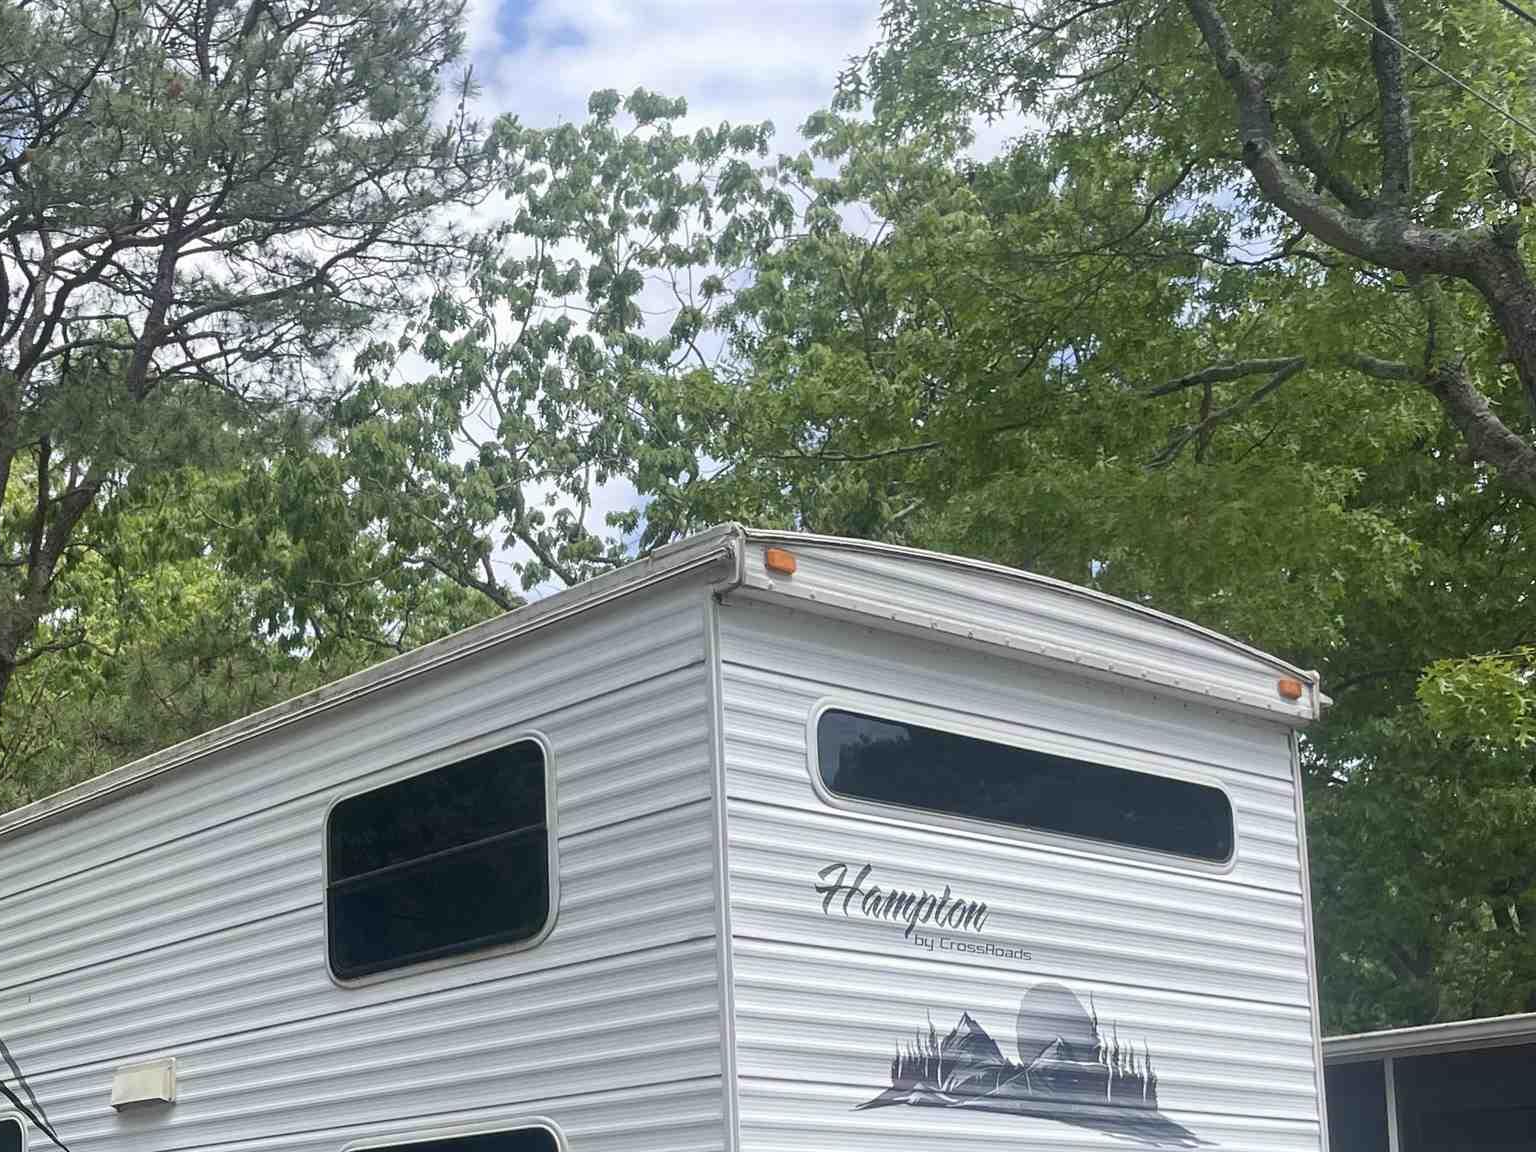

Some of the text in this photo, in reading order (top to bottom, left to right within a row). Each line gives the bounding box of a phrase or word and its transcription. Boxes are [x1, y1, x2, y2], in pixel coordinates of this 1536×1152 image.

[814, 863, 990, 939] Hampton
[914, 934, 1033, 960] by CrossRoads
